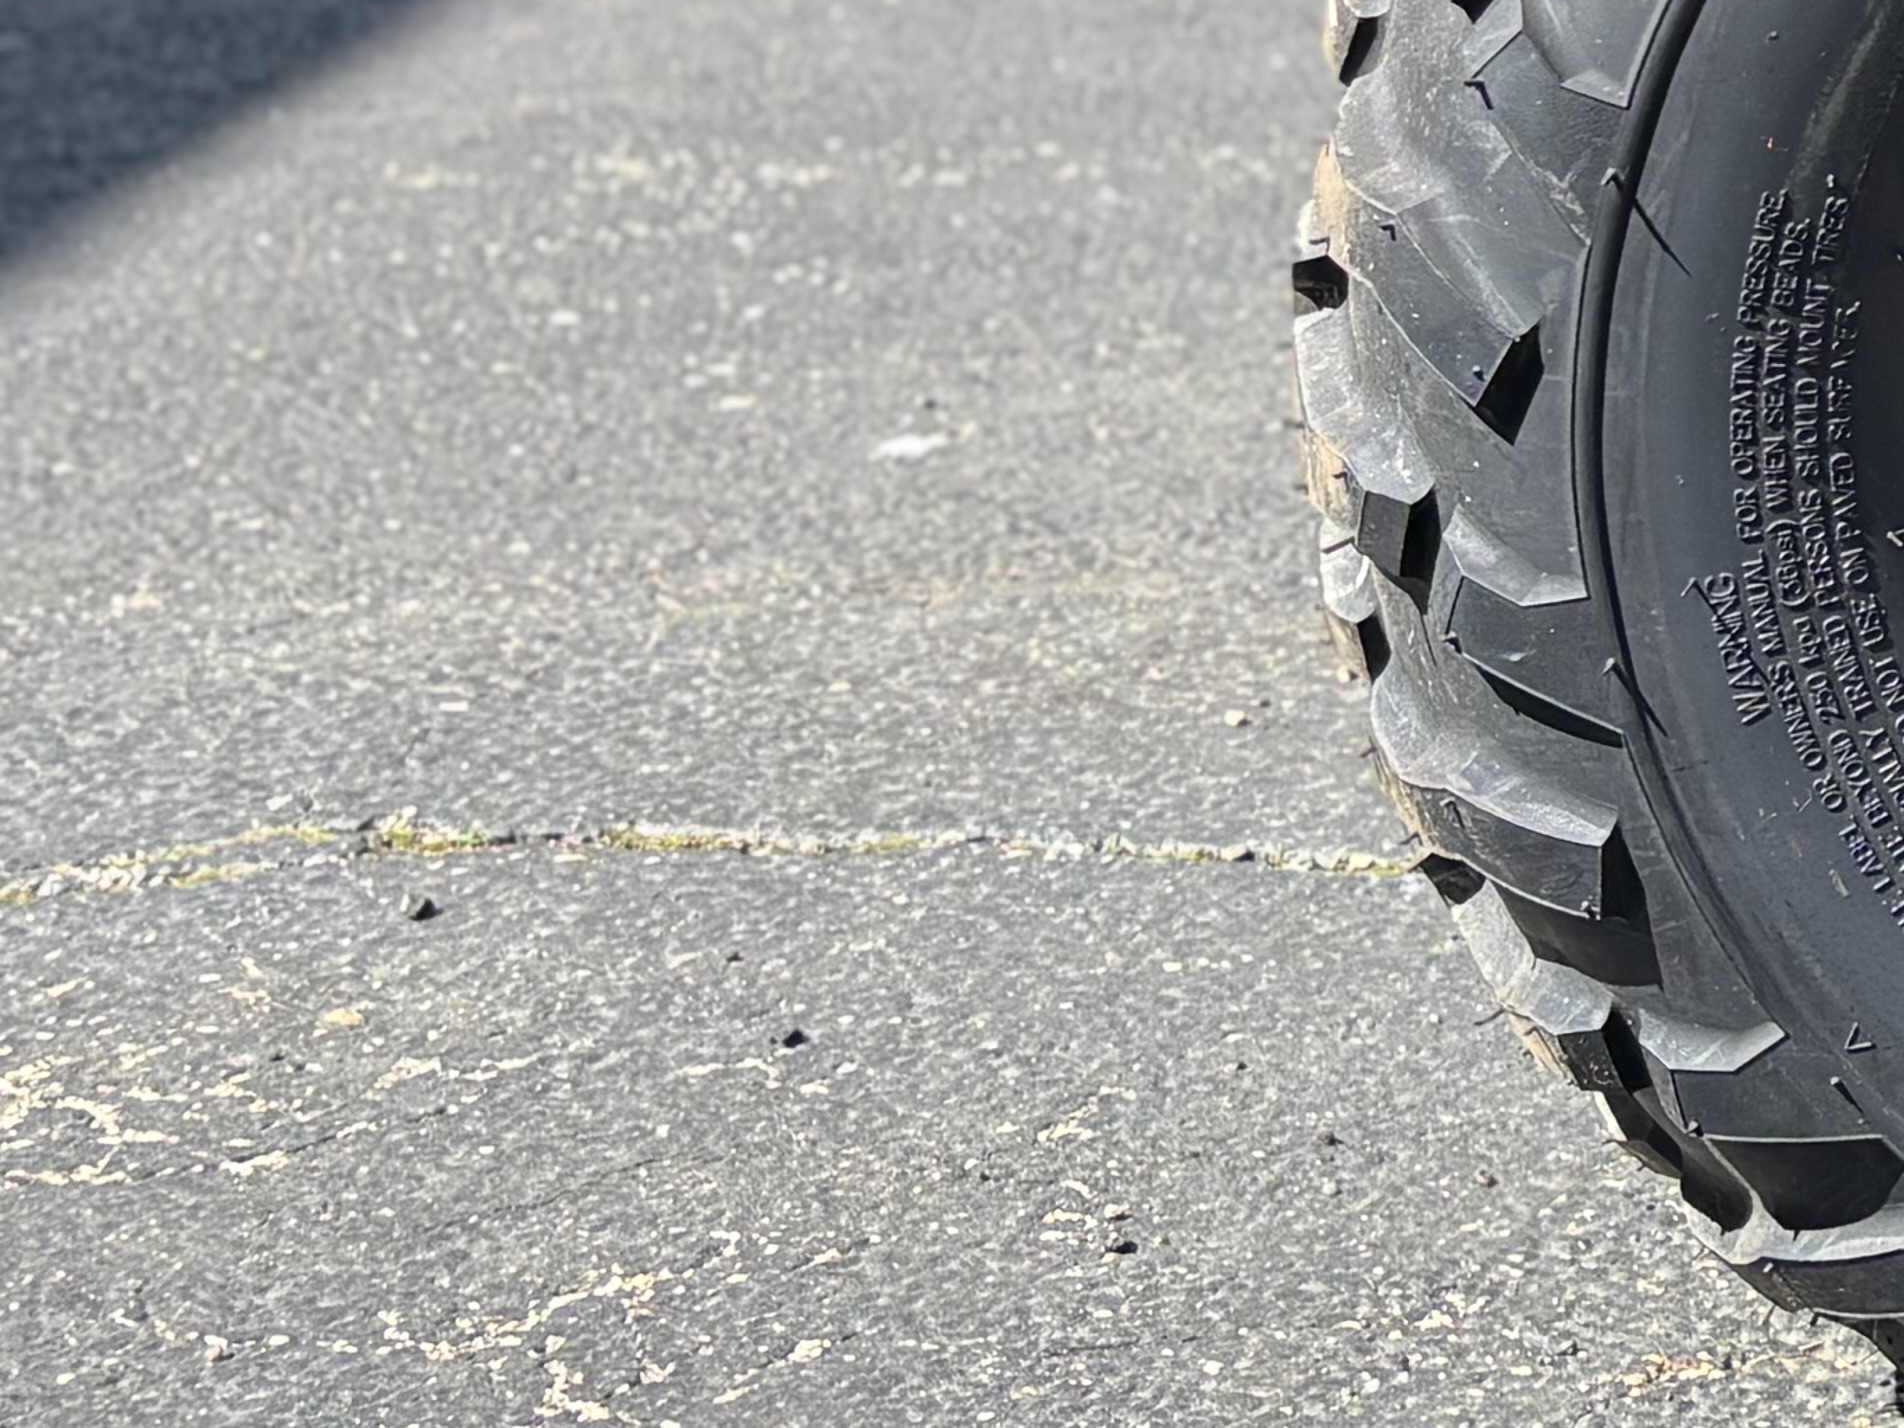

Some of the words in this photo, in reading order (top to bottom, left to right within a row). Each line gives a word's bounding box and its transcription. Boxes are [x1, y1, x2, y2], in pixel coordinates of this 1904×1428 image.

[1797, 278, 1832, 365] MOUNT
[1728, 336, 1759, 476] OPERATING
[1760, 315, 1793, 423] SEATING
[1760, 432, 1791, 507] WHEN
[1794, 376, 1824, 477] SHOULD
[1730, 486, 1761, 539] FOR
[1827, 450, 1863, 539] PAVED
[1795, 487, 1841, 607] PERSONS
[1839, 545, 1872, 586] ON
[1700, 568, 1774, 727] WARNING
[1737, 547, 1786, 654] MANUAL
[1801, 667, 1845, 725] 250
[1816, 612, 1878, 720] TRAINED
[1810, 768, 1849, 814] OR
[1824, 726, 1894, 825] BEYOND
[1831, 812, 1896, 894] LABEL
